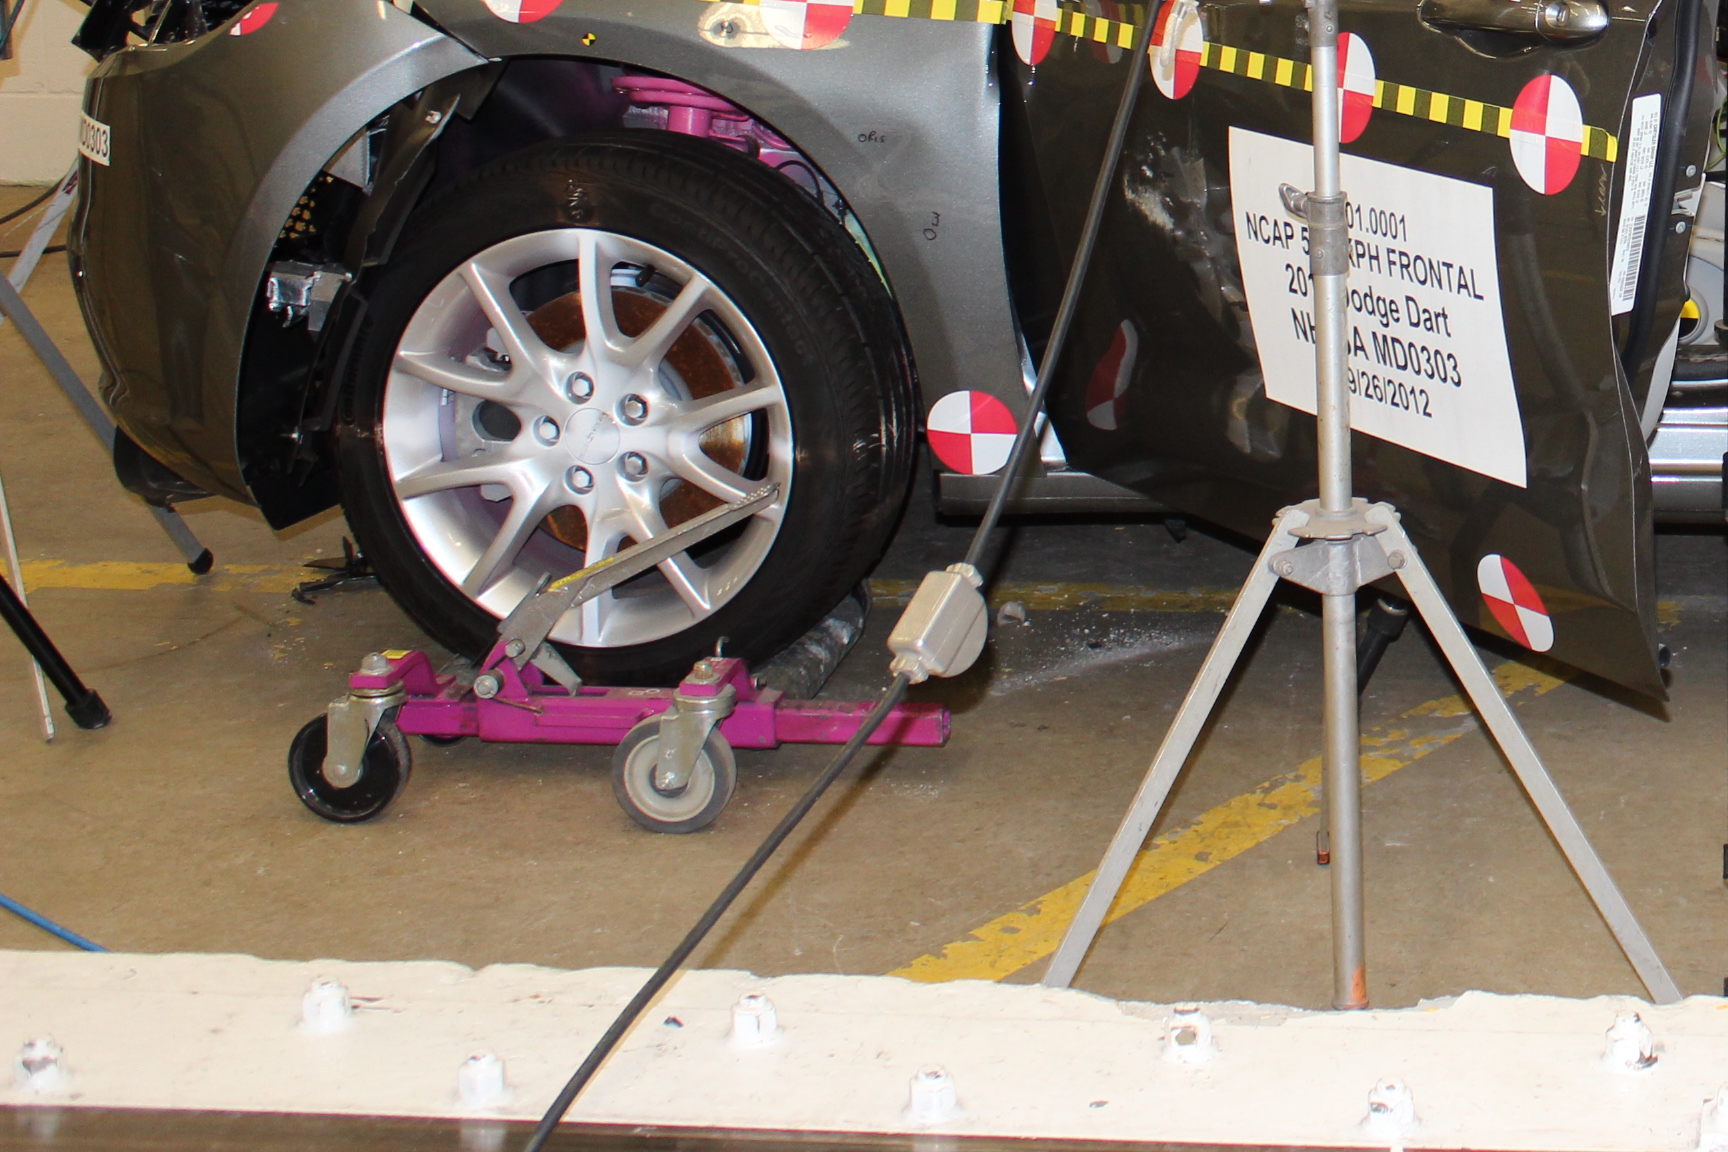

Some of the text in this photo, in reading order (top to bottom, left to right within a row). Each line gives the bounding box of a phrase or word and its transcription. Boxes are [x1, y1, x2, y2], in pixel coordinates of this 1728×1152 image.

[1245, 211, 1295, 250] NCAP
[1387, 247, 1485, 301] FRONTAL
[1285, 262, 1452, 338] 201 odge Dart
[1371, 330, 1462, 388] MD0303
